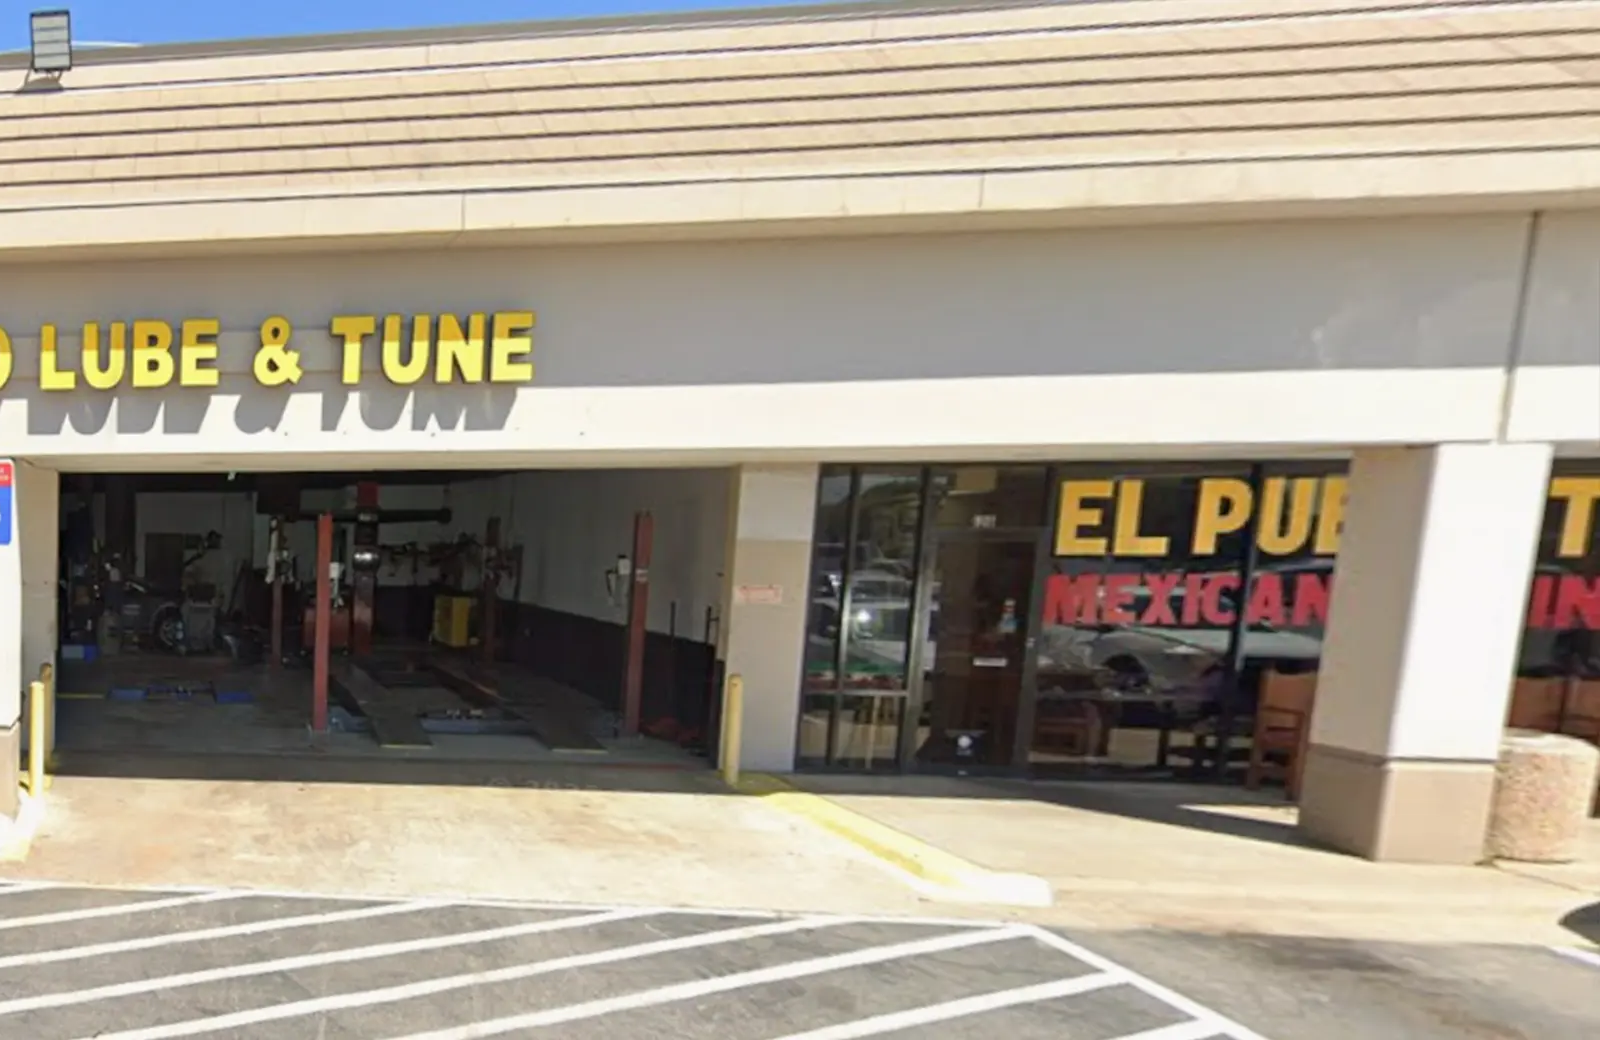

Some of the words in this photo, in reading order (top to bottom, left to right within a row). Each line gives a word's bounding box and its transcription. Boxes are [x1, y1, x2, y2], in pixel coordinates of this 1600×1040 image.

[40, 319, 219, 390] LUBE
[253, 315, 303, 386] &
[331, 311, 535, 385] TUNE
[1055, 479, 1169, 556] EL
[1043, 572, 1334, 626] MEXICAN
